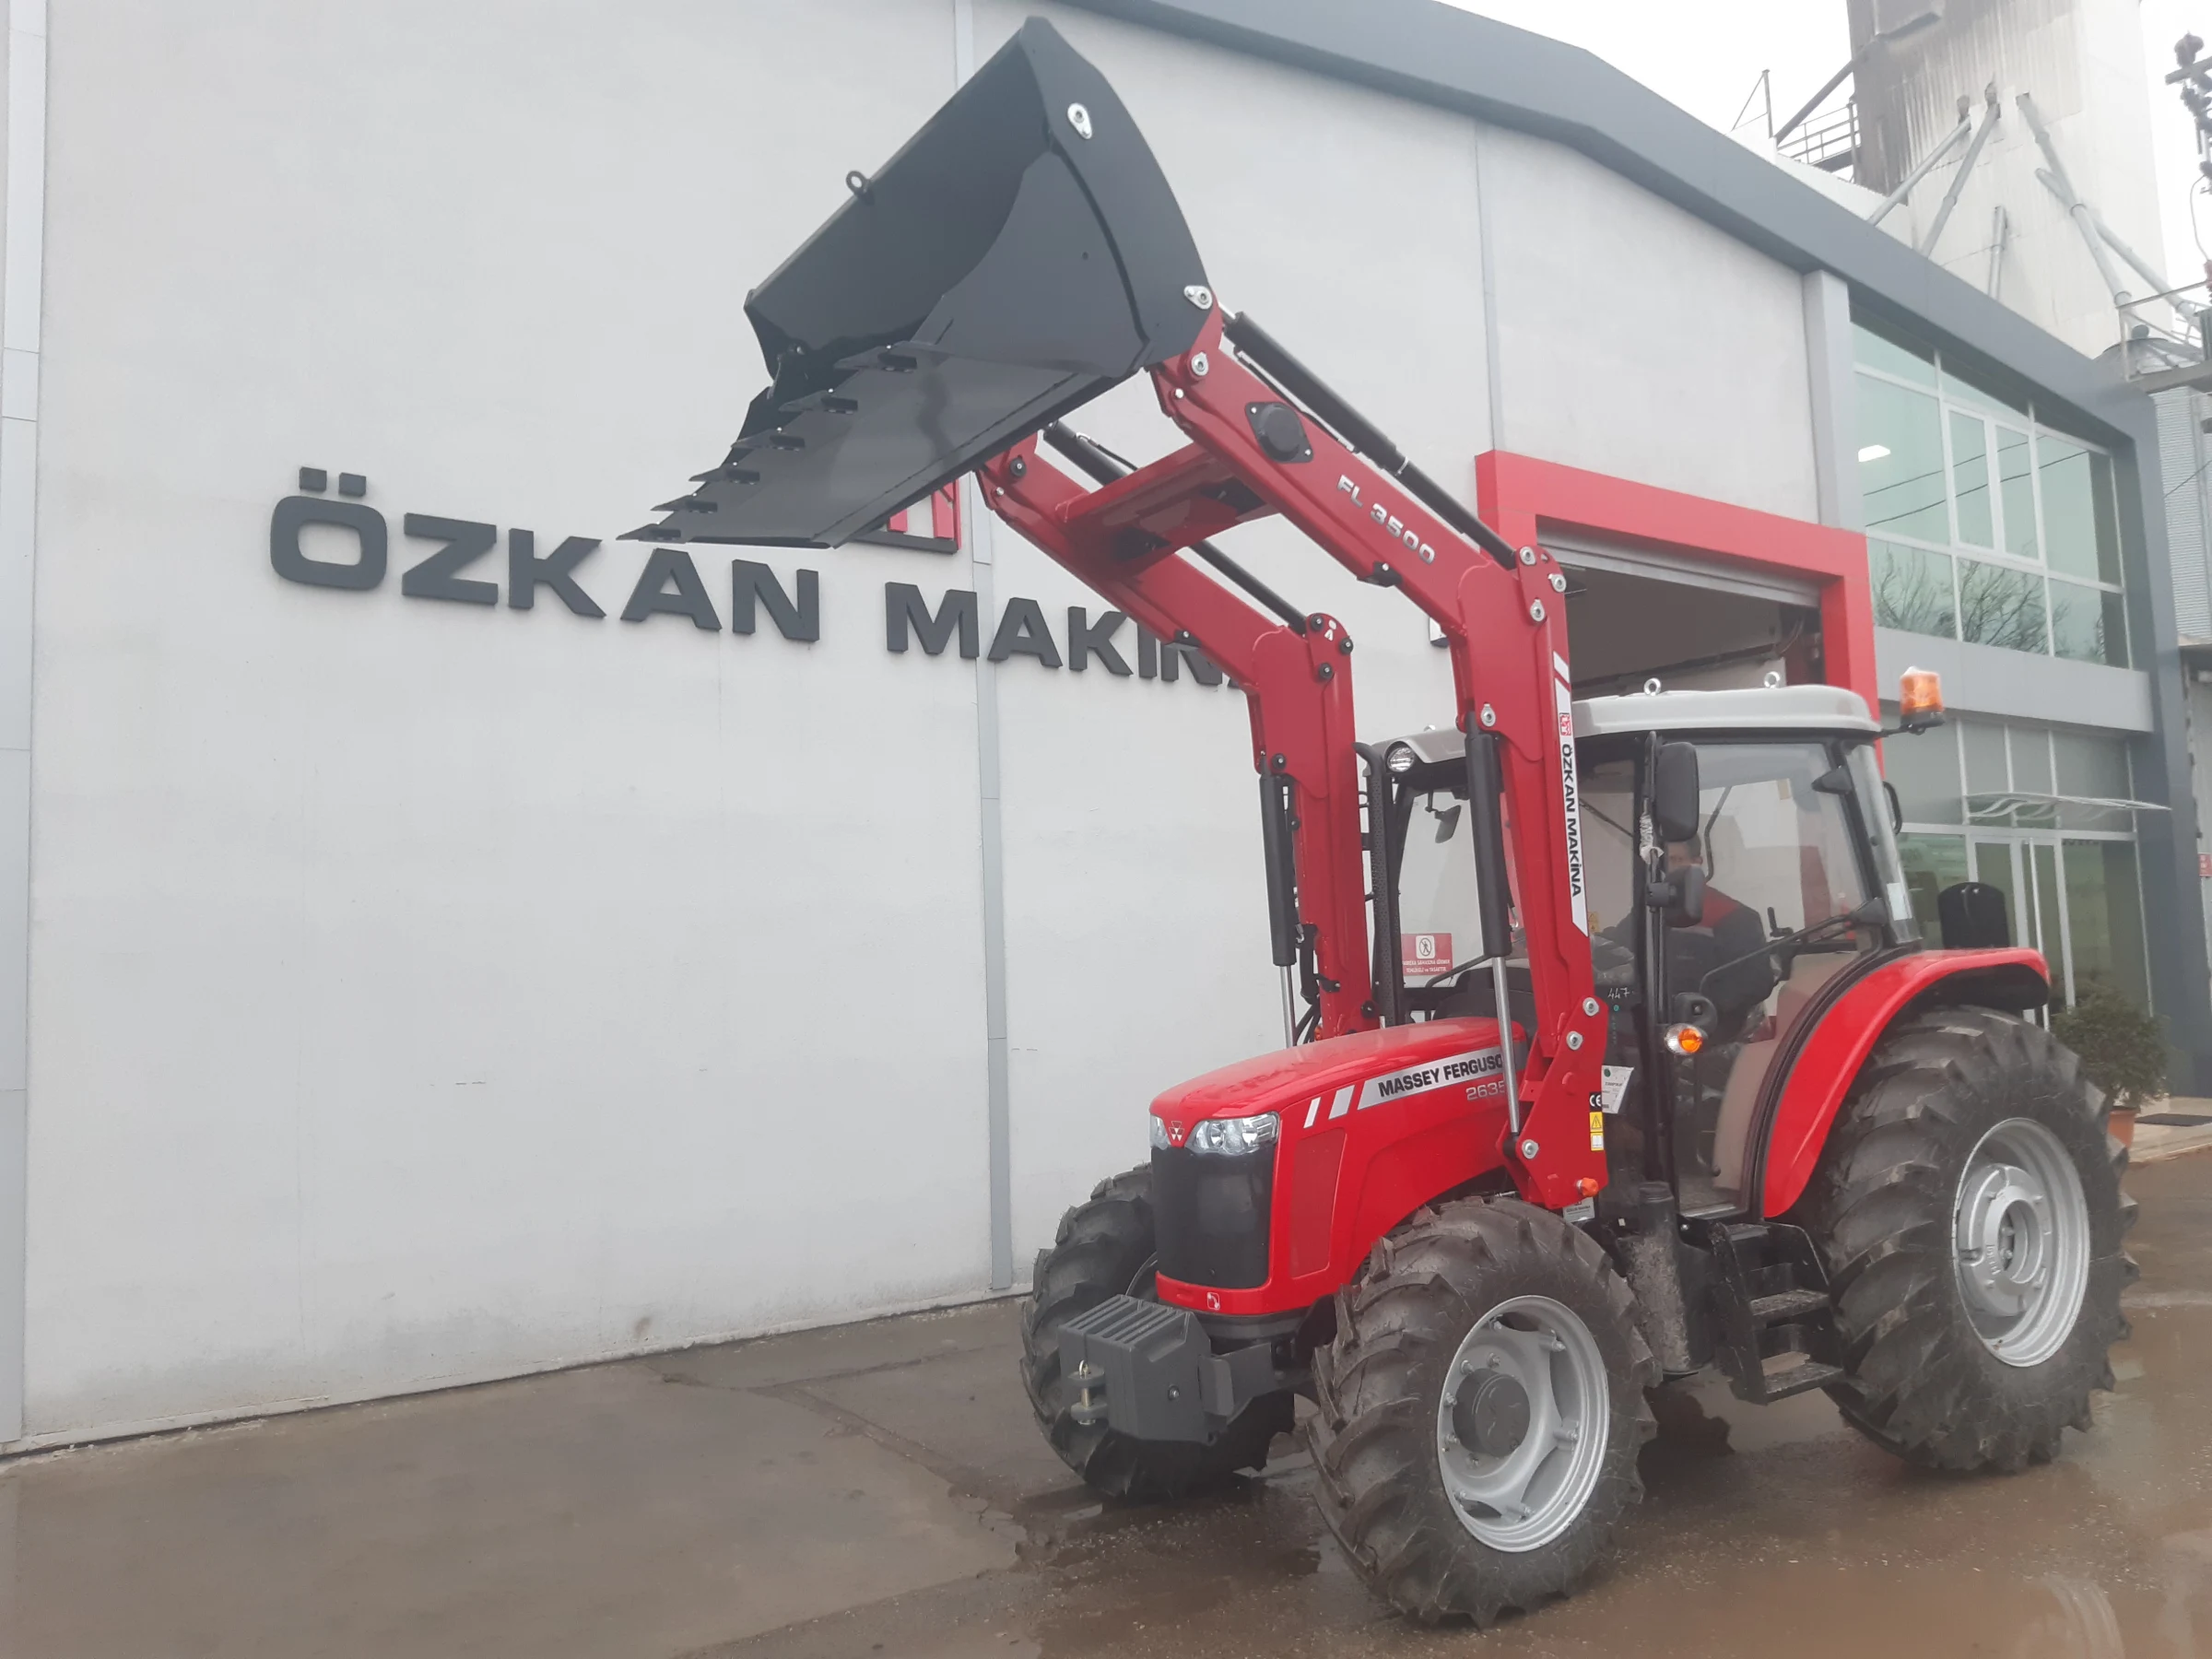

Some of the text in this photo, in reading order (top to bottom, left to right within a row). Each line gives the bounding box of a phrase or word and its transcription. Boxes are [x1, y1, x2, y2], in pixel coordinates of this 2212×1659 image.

[270, 465, 819, 643] ÖZKAN
[1336, 474, 1436, 565] FL 3500
[1562, 744, 1575, 813] ÖZKAN
[1378, 1053, 1503, 1098] MASSEY FERGUSO
